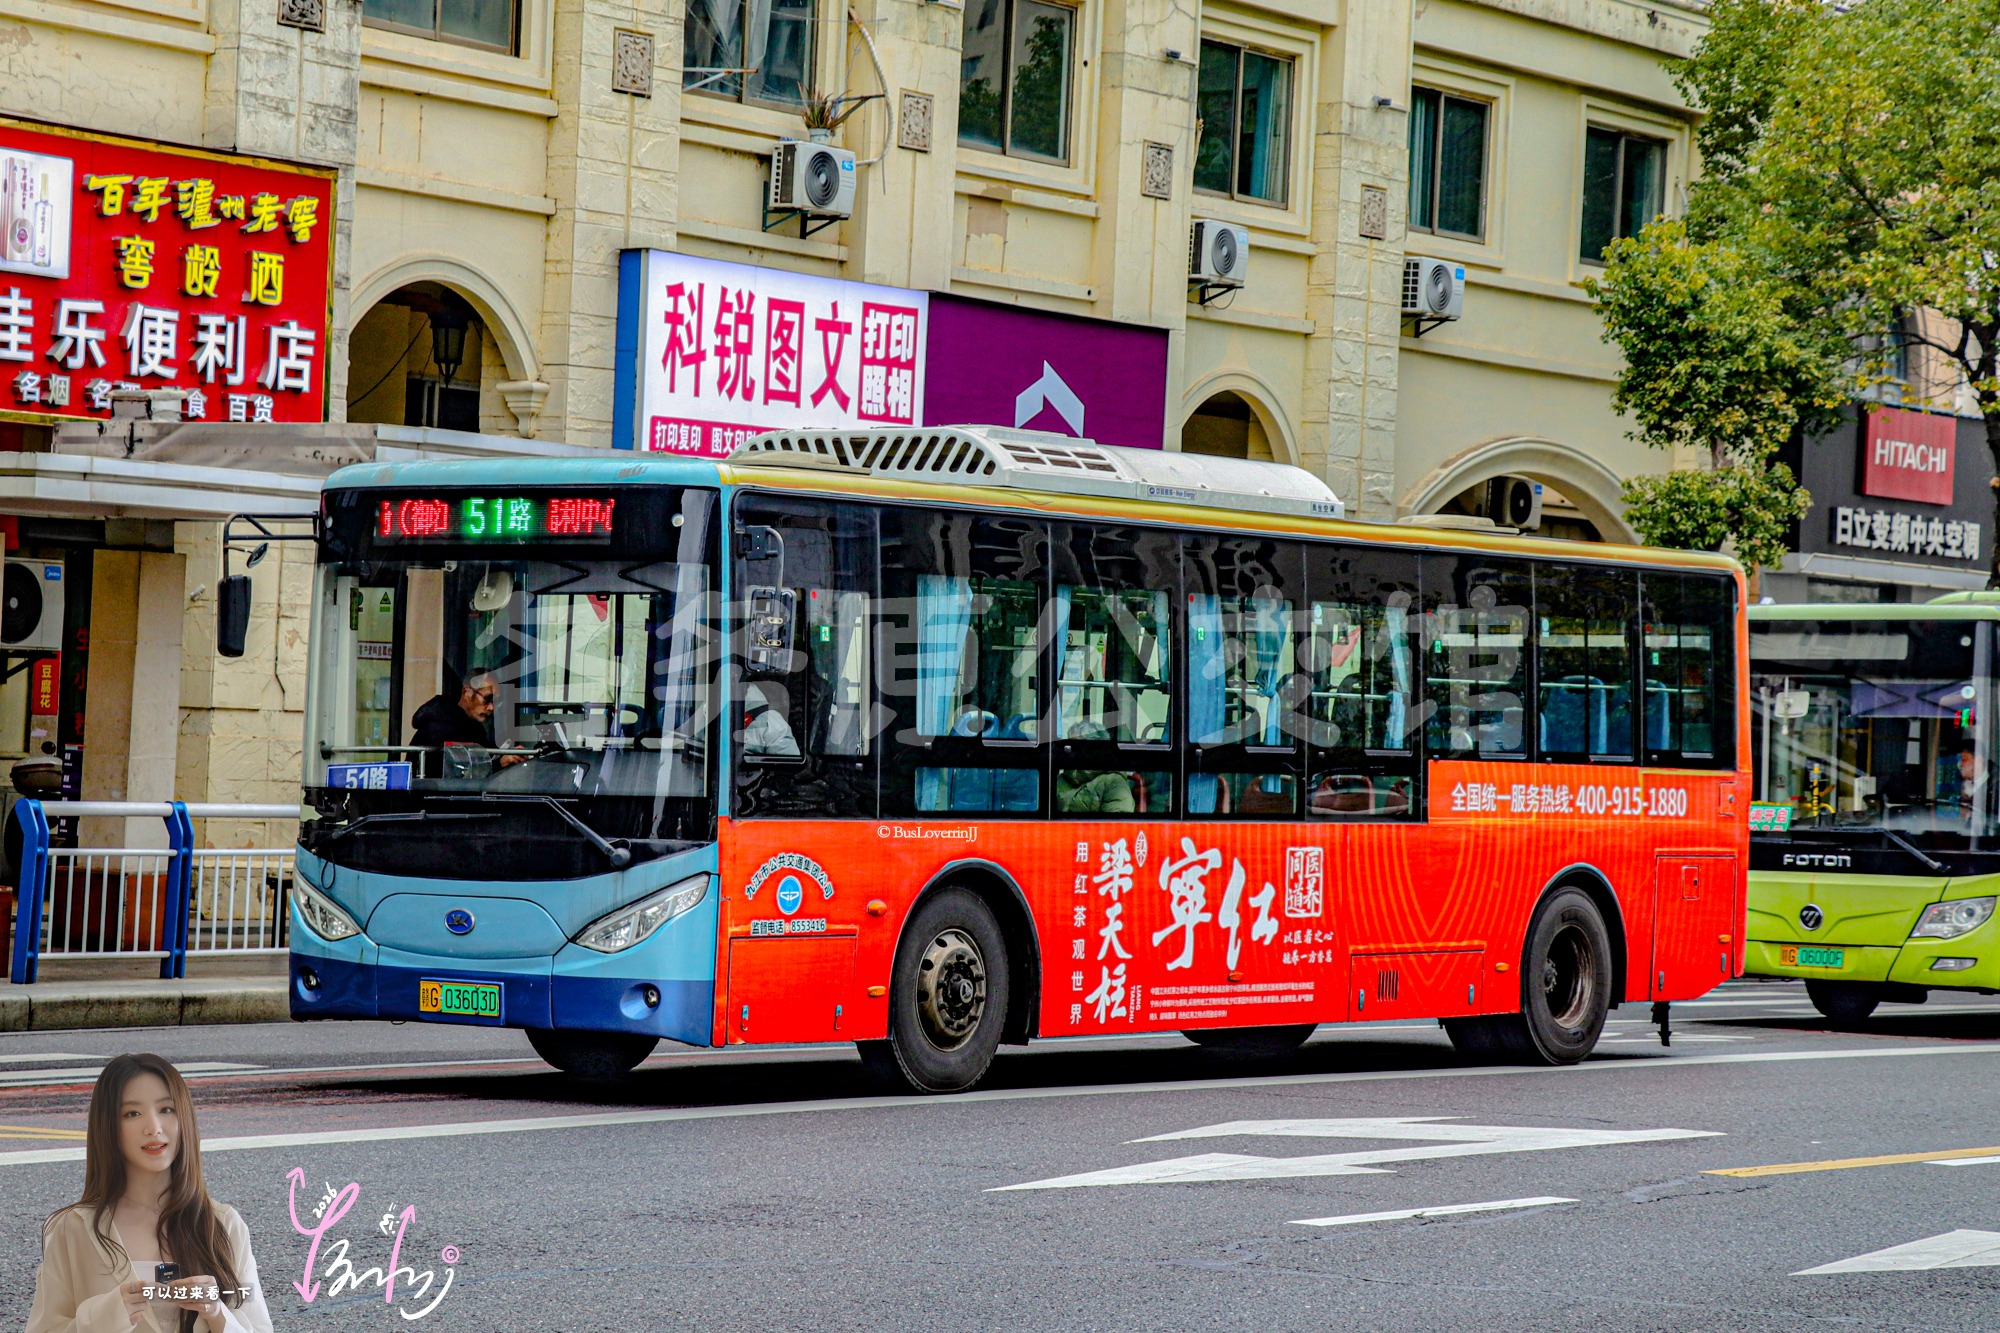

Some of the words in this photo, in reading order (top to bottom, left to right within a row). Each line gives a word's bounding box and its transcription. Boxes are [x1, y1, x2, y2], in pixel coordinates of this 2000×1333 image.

[85, 173, 319, 242] 百年泸州老窖
[118, 234, 285, 306] 窖龄酒
[662, 281, 852, 414] 科锐图文
[864, 308, 914, 363] 打印
[17, 371, 70, 406] 名烟
[228, 394, 274, 422] 百货
[861, 365, 912, 418] 照相
[655, 421, 701, 451] 打印复印
[1875, 438, 1946, 473] HITACHI
[470, 498, 532, 534] 51路
[1836, 507, 1980, 560] 日立变频中央空调
[345, 766, 388, 790] 51路
[745, 852, 834, 900] 九江市公共交通集团公司
[1783, 854, 1851, 867] FOTON
[1070, 842, 1088, 1025] 用红茶观世界
[1085, 838, 1133, 1024] 梁天柱
